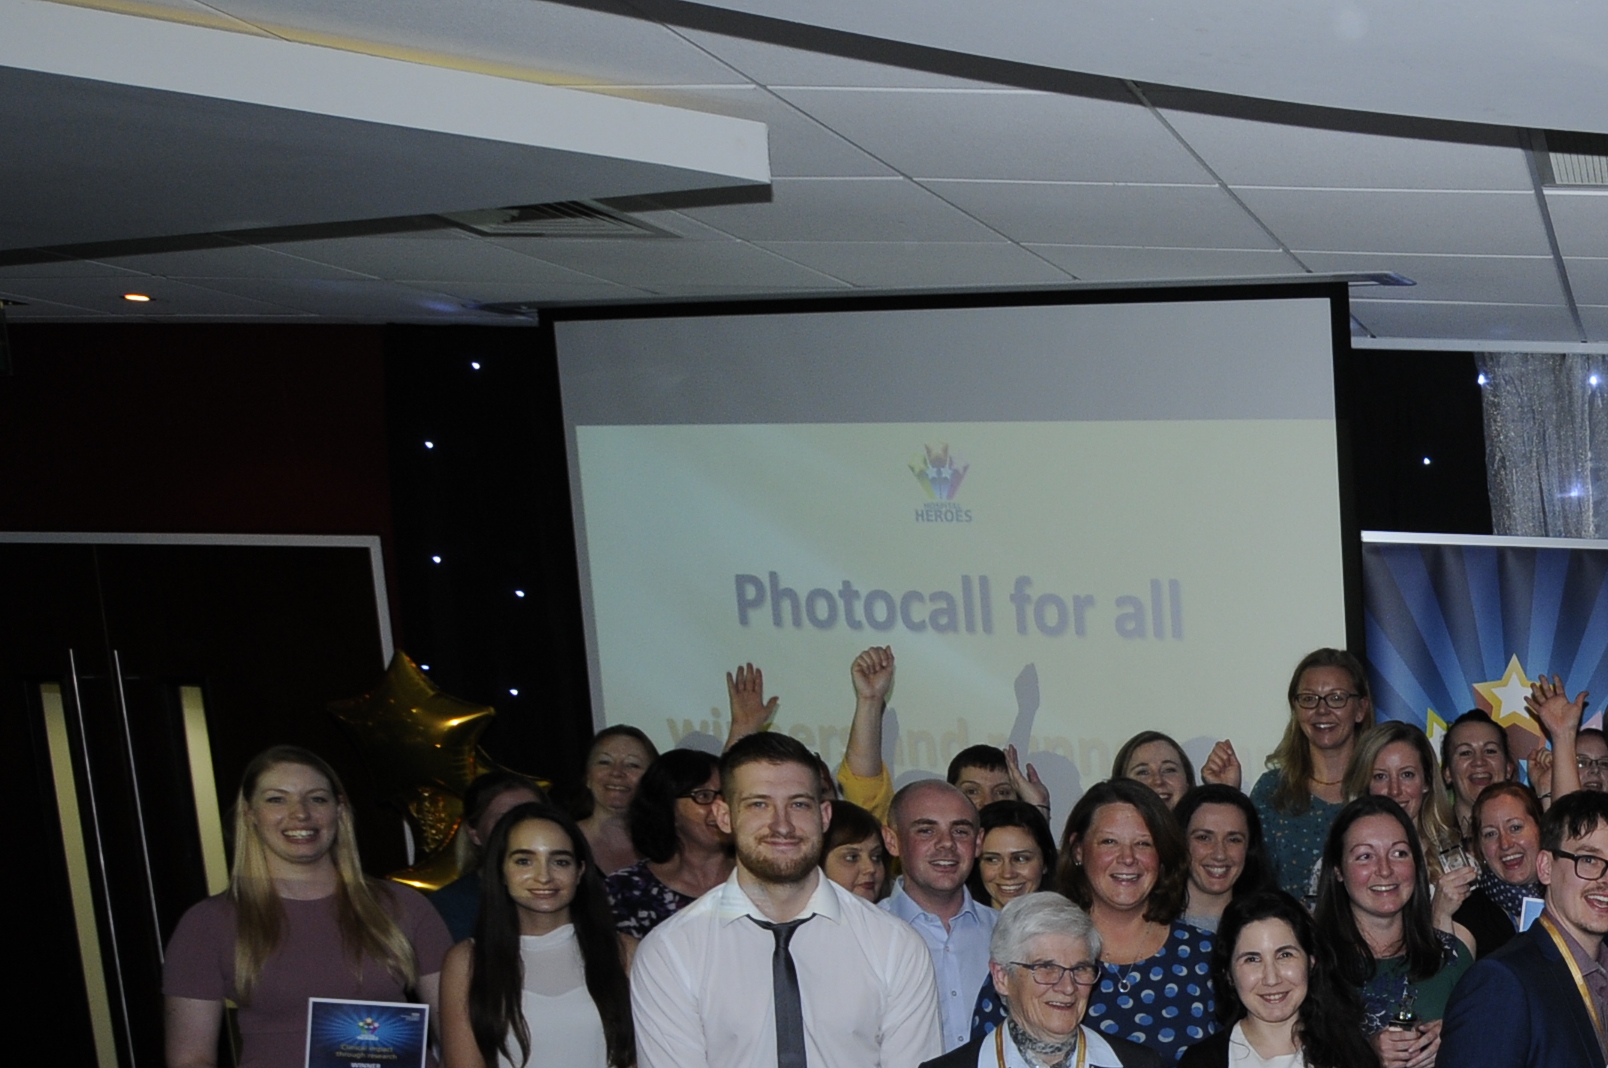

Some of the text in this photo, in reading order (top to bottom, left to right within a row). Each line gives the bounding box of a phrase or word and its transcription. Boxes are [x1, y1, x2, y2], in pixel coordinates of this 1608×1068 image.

[915, 509, 972, 522] HEROES
[734, 571, 1184, 641] Photocall for all
